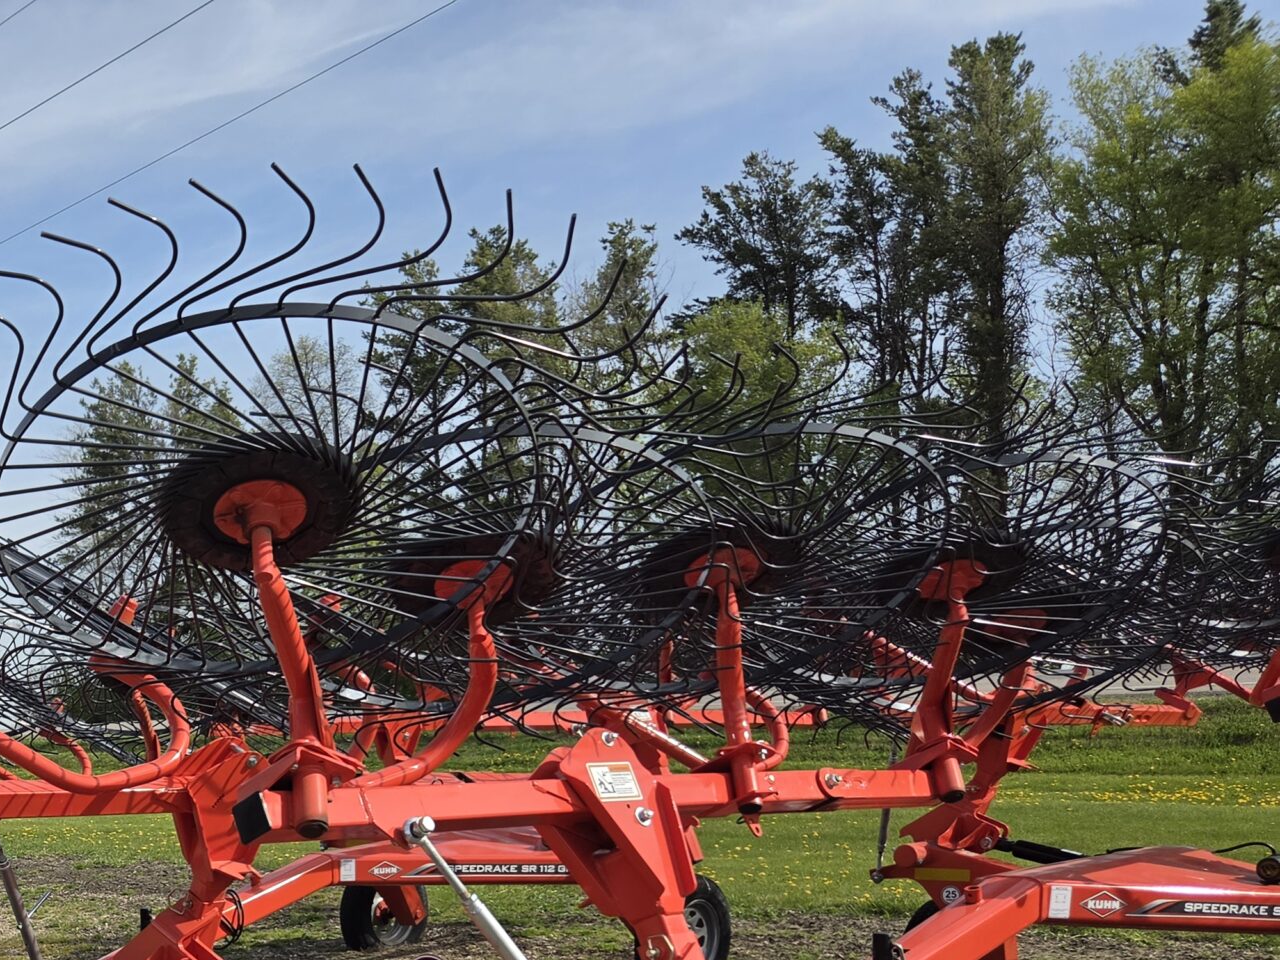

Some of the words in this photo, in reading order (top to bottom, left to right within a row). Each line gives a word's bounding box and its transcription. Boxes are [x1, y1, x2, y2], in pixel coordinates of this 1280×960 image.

[373, 867, 401, 875] KUHN
[448, 864, 518, 873] SPEEDRAKE
[521, 865, 537, 873] SR
[539, 865, 556, 873] 112
[945, 890, 957, 898] 25
[1087, 900, 1120, 910] KUHN
[1184, 903, 1268, 915] SPEEDRAKE
